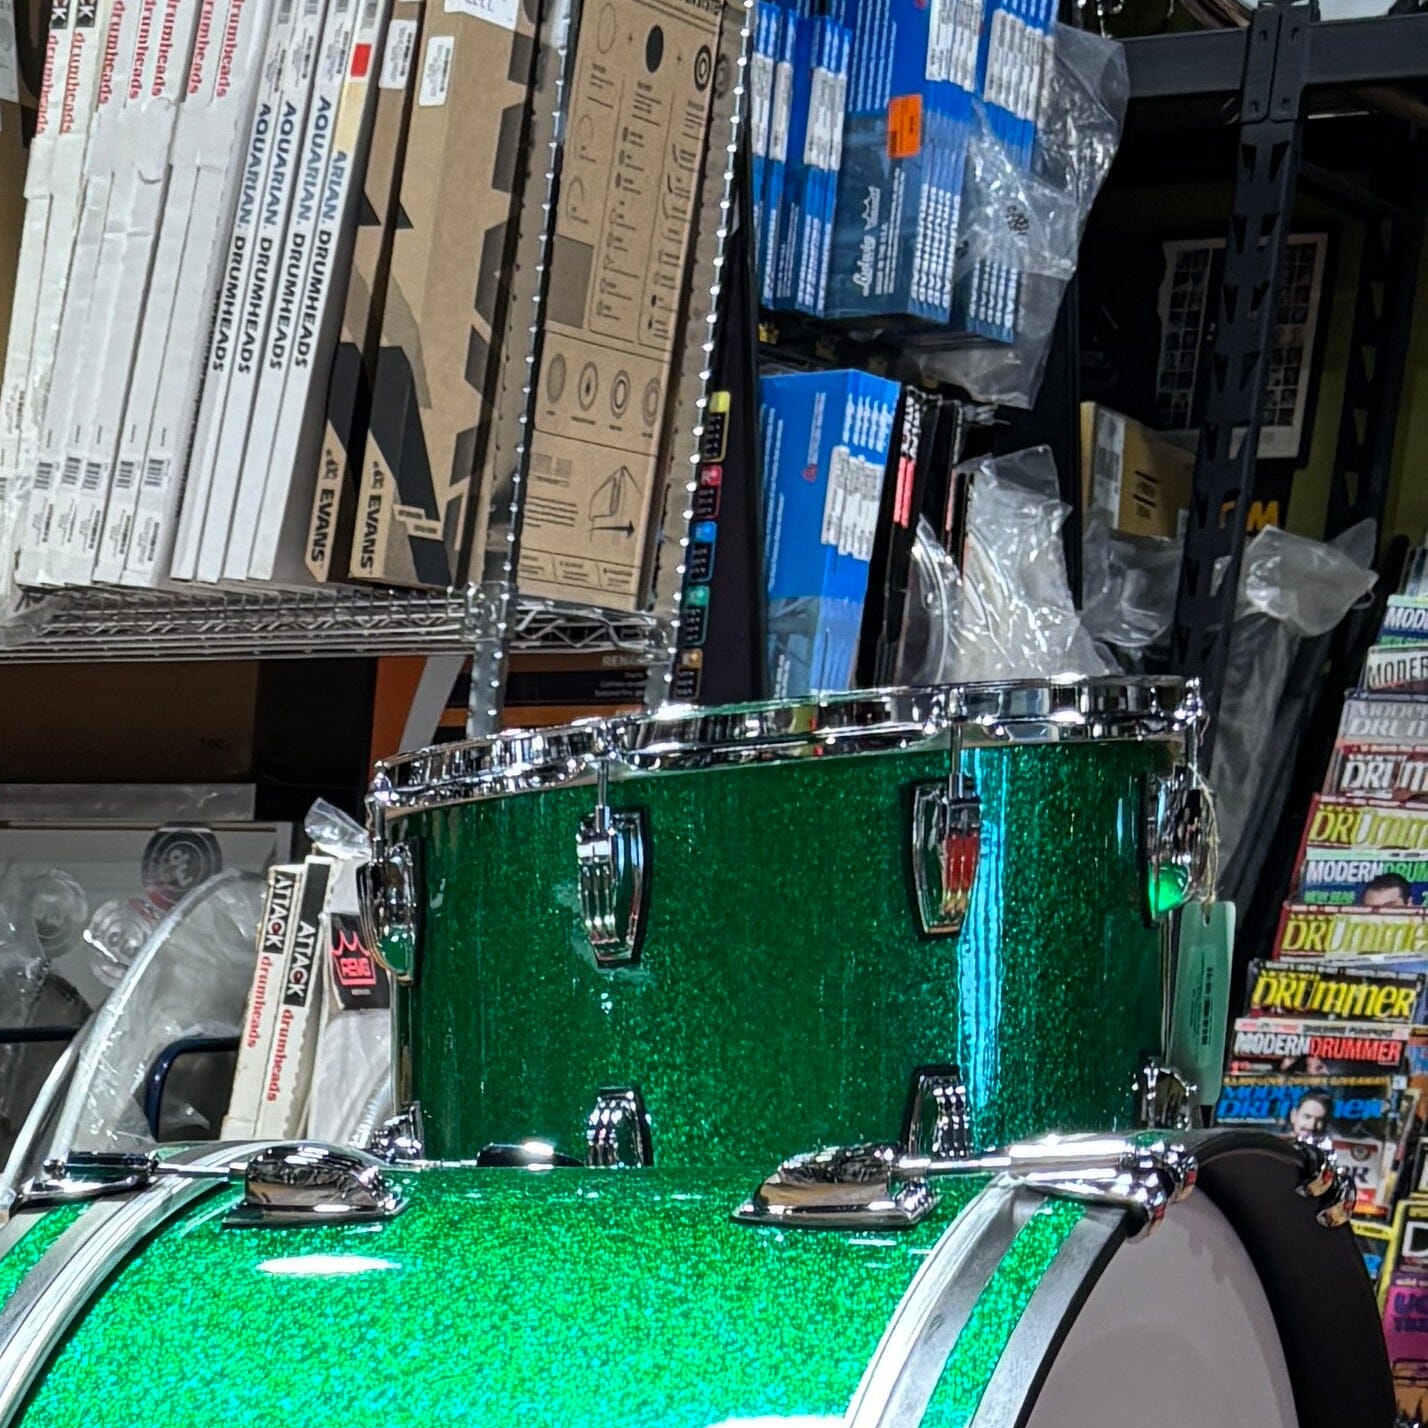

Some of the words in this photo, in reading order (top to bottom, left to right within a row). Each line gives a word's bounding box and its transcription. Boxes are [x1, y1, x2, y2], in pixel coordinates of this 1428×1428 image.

[36, 35, 58, 134] drumheads
[61, 32, 85, 134] drumheads
[99, 1, 126, 104] drumheads
[187, 0, 215, 94] rumheads
[213, 236, 246, 371] DRUMHEADS
[238, 237, 272, 373] DRUMHEADS
[270, 233, 305, 370] DRUMHEADS
[295, 230, 332, 368] DRUMHEADS
[311, 489, 335, 563] EVANS
[360, 495, 382, 569] EVANS
[264, 875, 295, 948] ATTACK
[247, 955, 274, 1048] drumheads
[286, 921, 317, 997] ATTACK
[267, 1009, 295, 1102] drumheads
[1235, 1032, 1310, 1056] MODERN
[1309, 1036, 1402, 1066] DRUMMER
